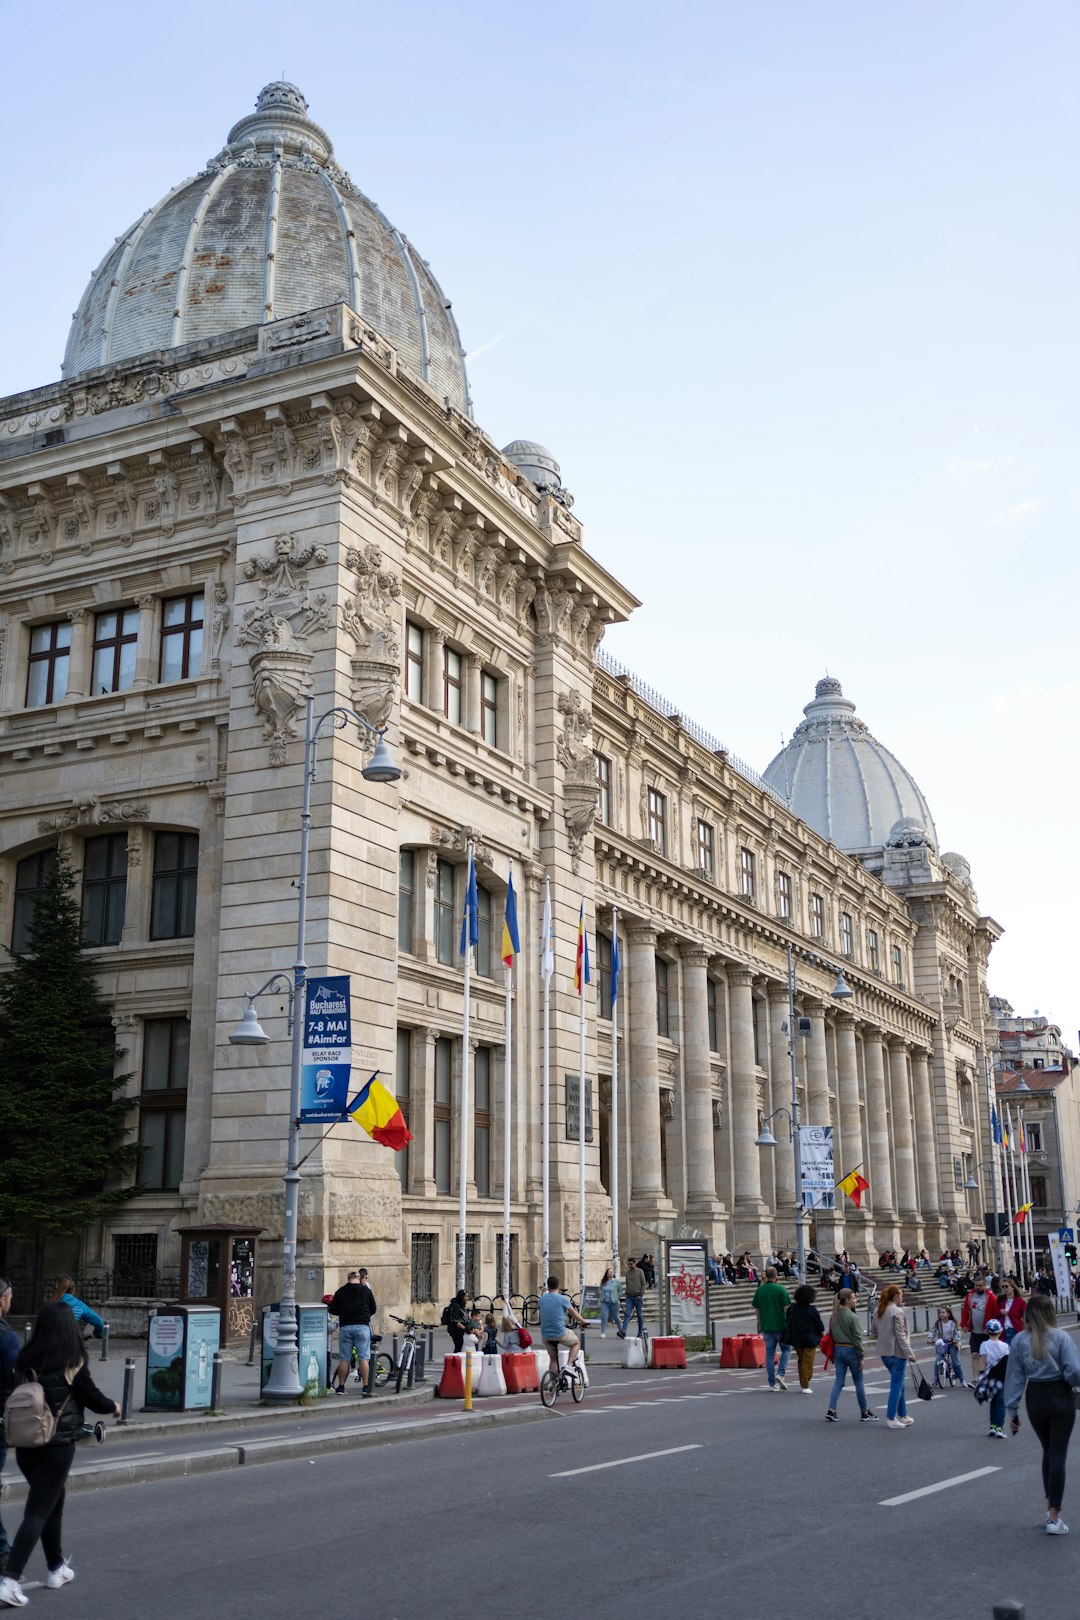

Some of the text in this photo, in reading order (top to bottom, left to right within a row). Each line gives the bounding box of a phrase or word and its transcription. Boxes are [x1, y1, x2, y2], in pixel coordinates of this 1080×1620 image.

[310, 1000, 346, 1009] Bucharest
[308, 1020, 347, 1032] 7-8 MAI
[308, 1034, 347, 1044] #AimFar
[316, 1078, 330, 1092] fit
